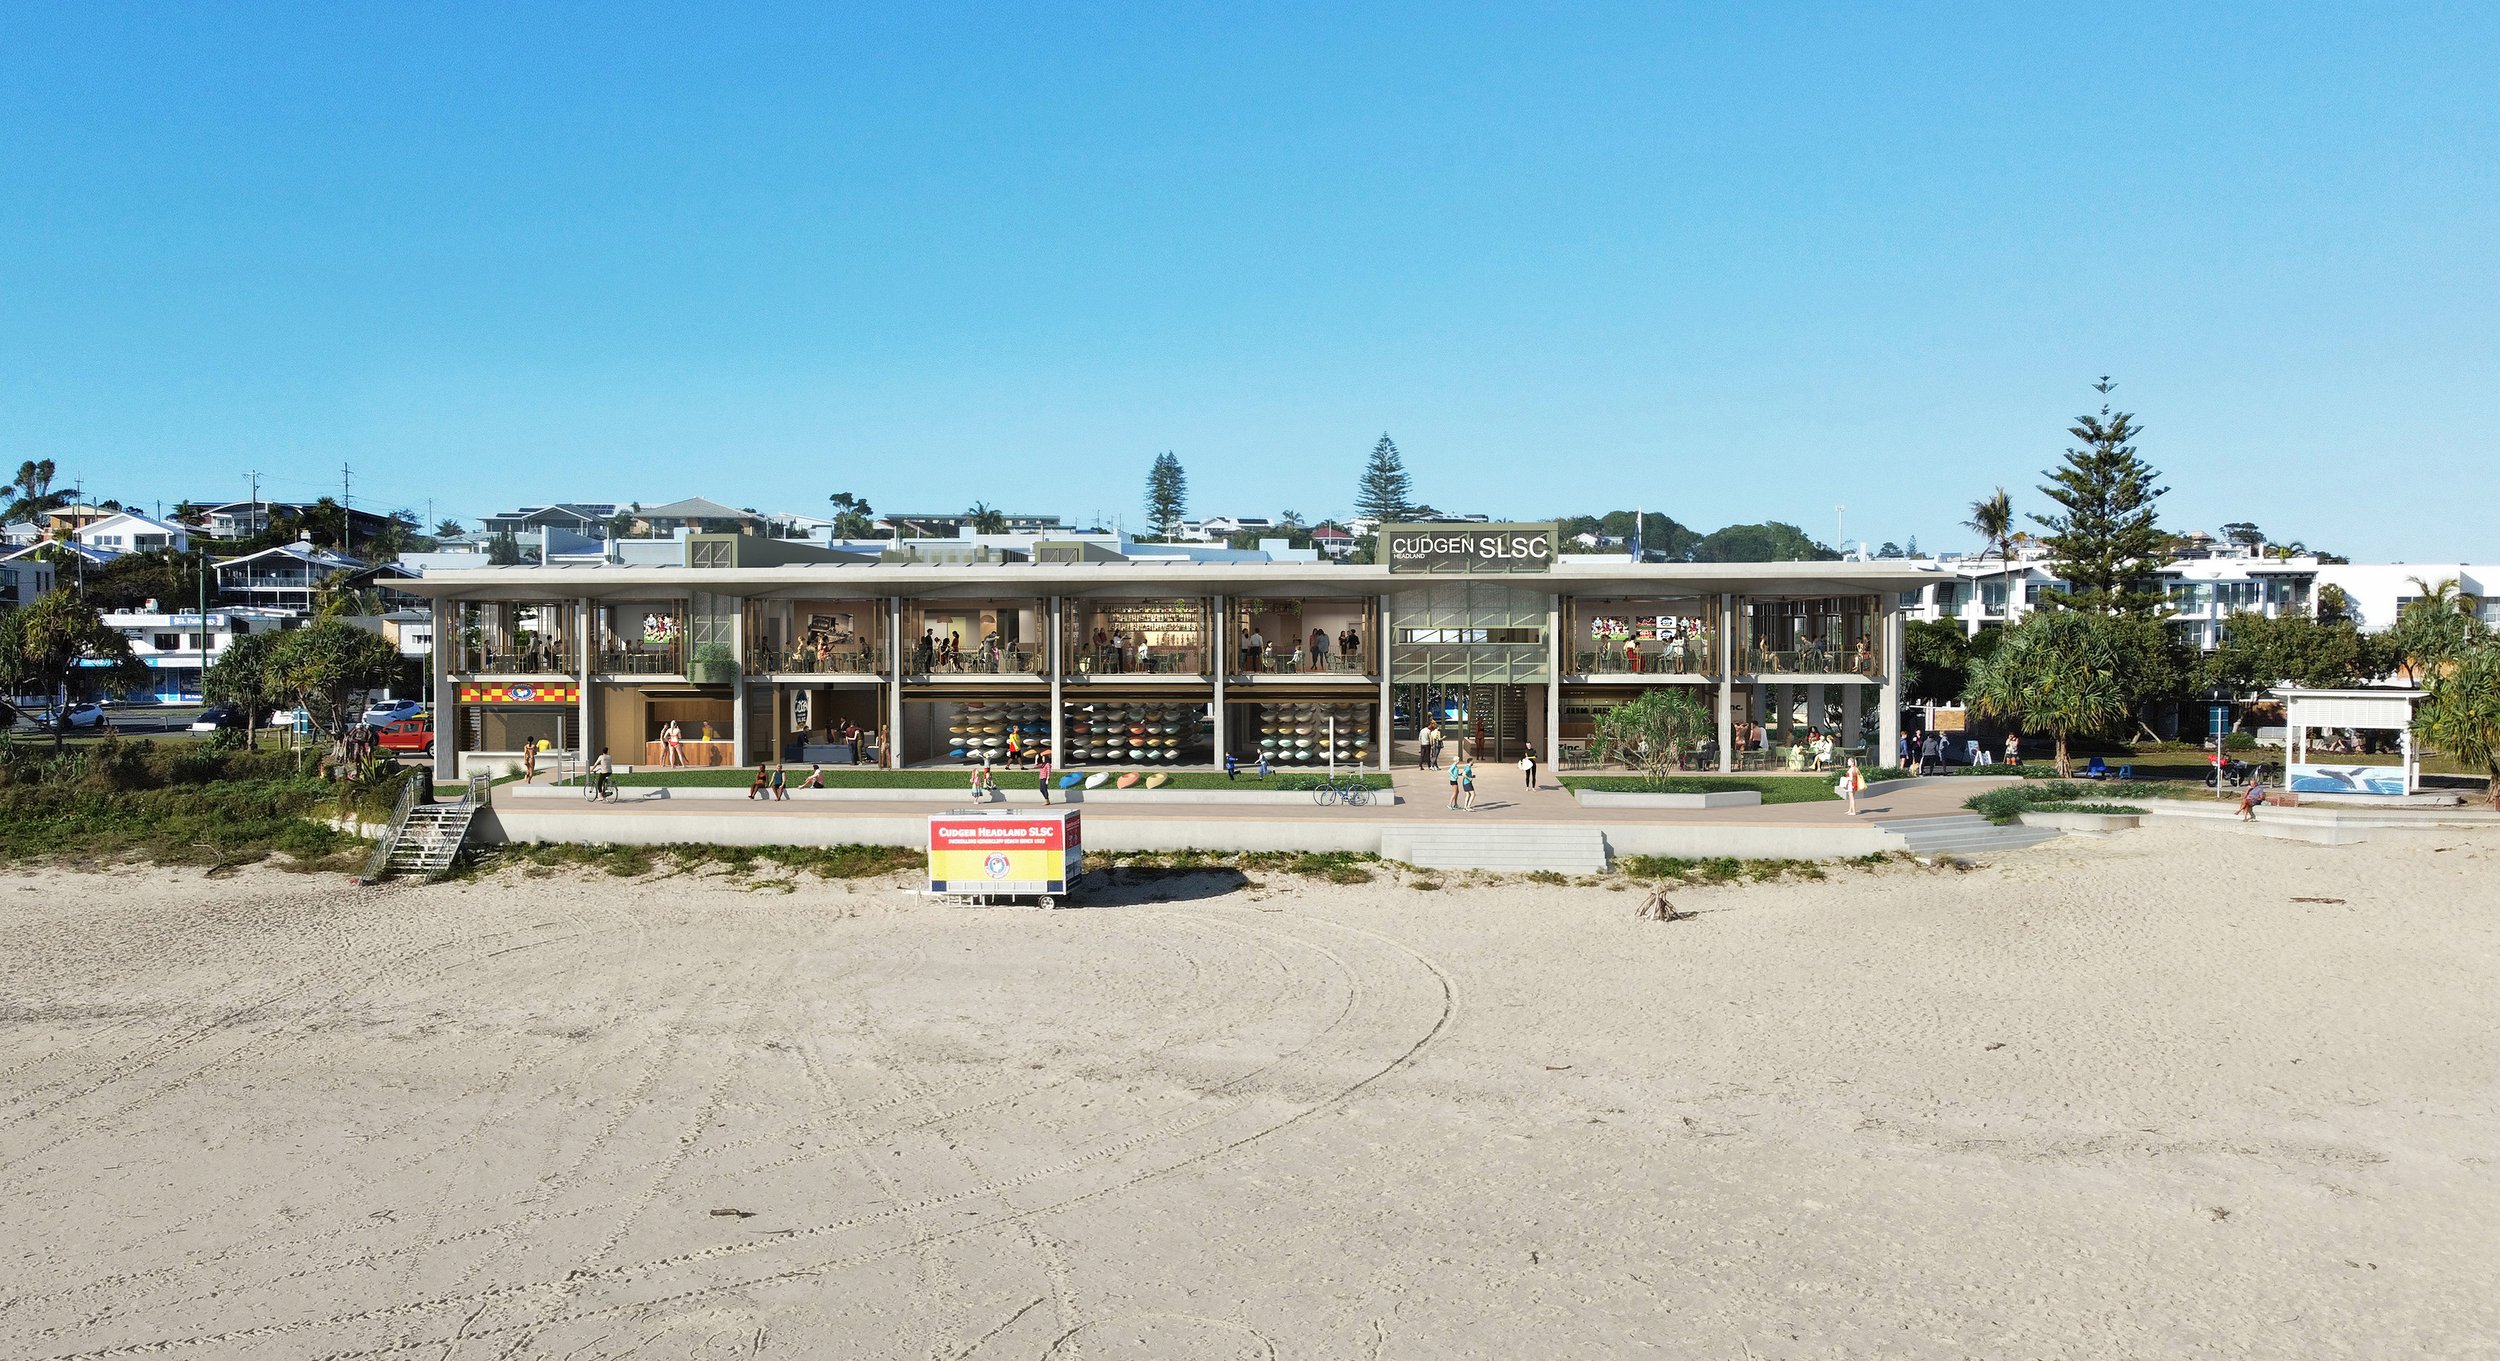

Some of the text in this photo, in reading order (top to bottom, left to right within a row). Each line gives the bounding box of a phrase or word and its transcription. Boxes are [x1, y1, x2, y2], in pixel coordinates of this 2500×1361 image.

[1393, 537, 1548, 559] CUDGEN SLSC
[1029, 827, 1054, 836] SLSC
